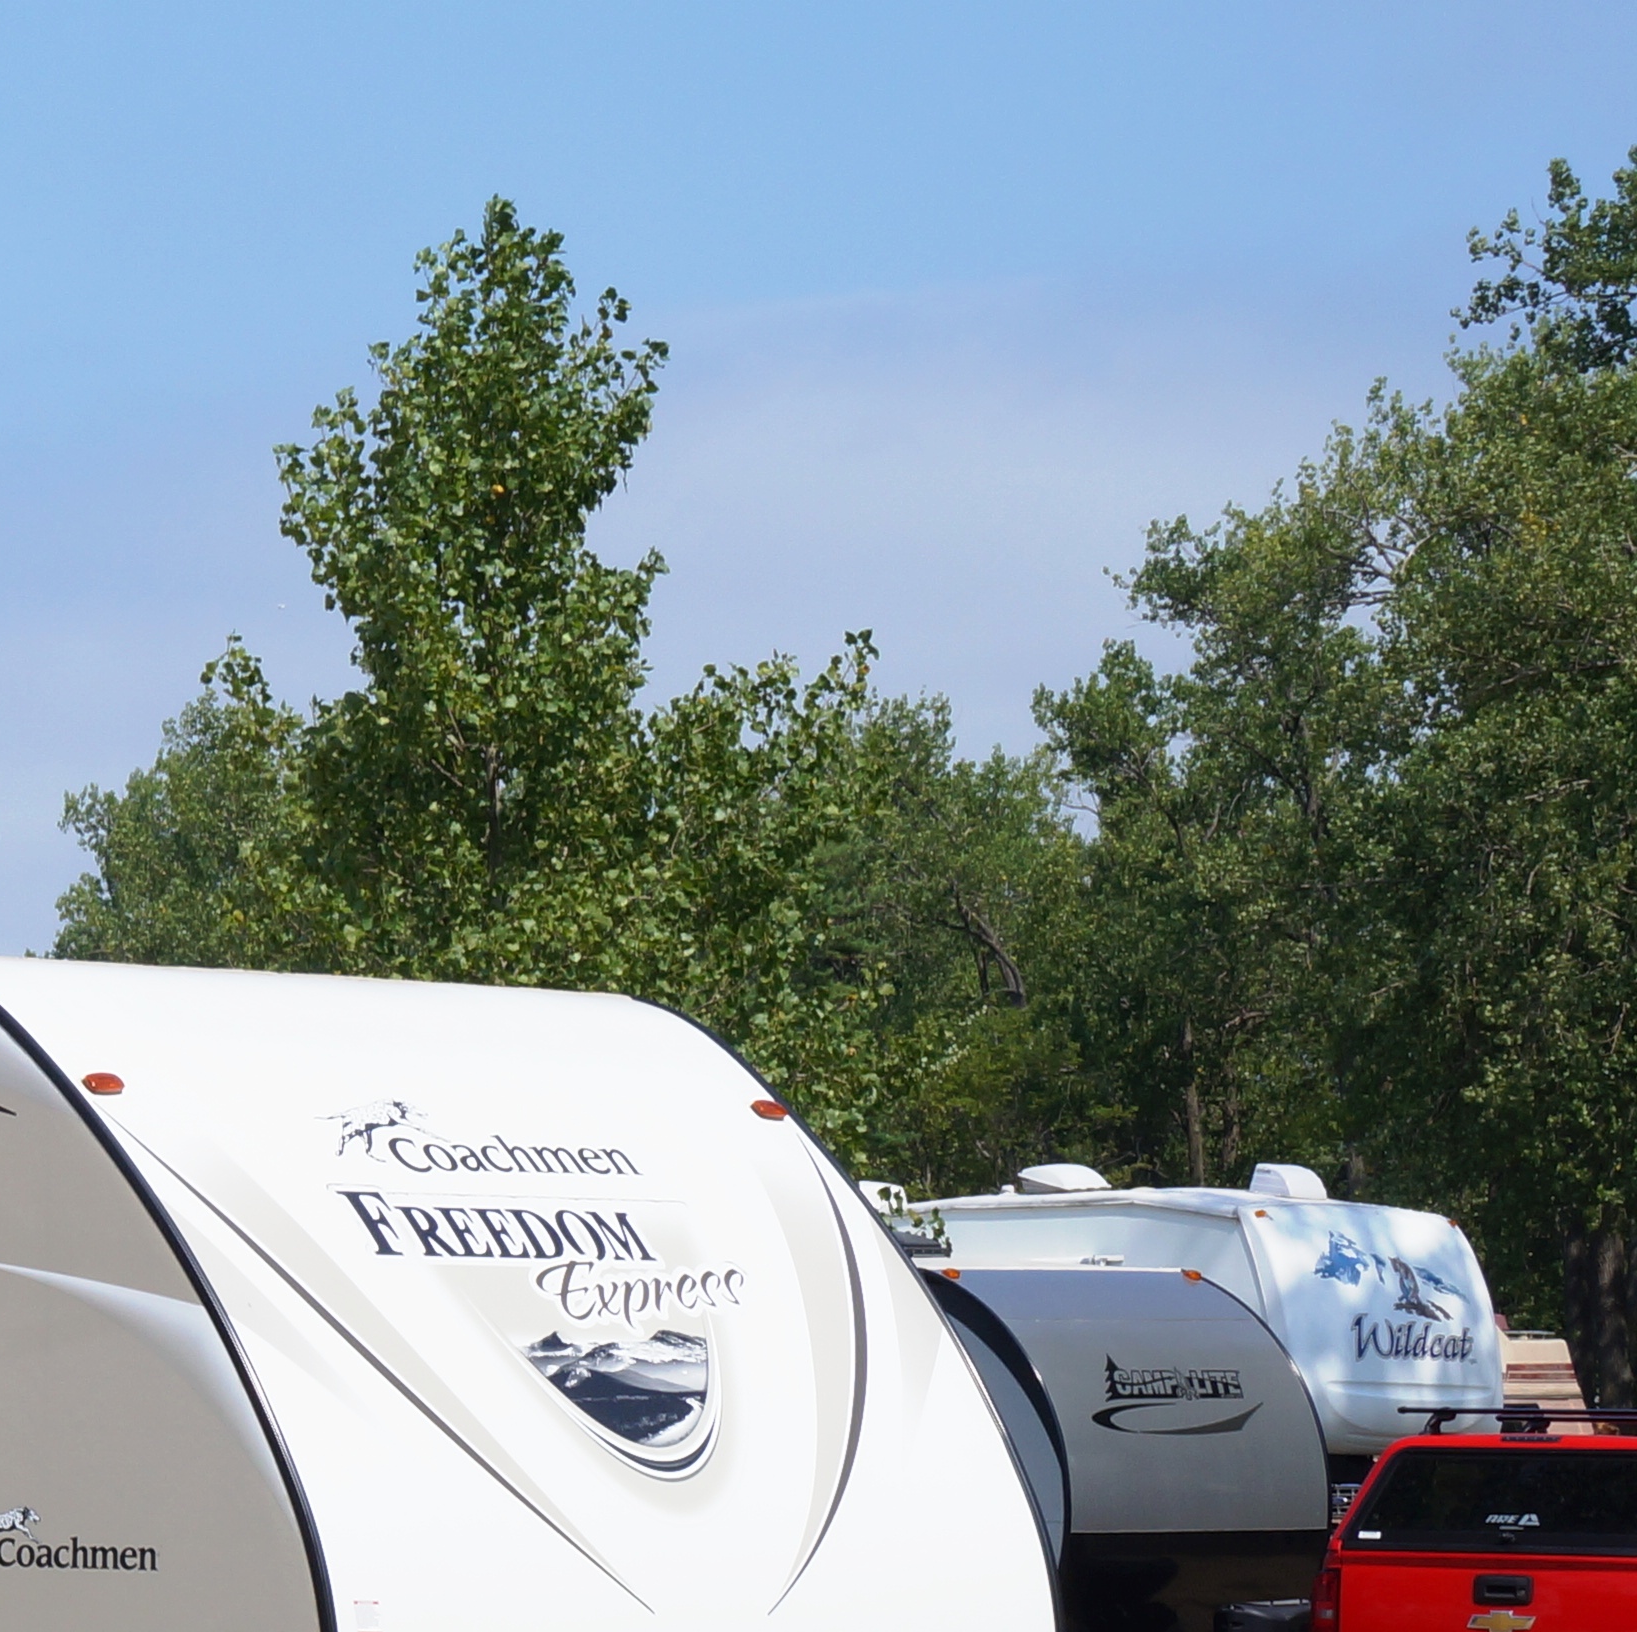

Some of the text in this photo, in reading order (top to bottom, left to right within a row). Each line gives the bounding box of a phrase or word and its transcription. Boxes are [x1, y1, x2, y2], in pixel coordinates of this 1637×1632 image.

[387, 1135, 643, 1176] Coachmen
[336, 1190, 657, 1261] FREEDOM
[535, 1260, 744, 1328] Express
[1350, 1313, 1474, 1362] Wildcat
